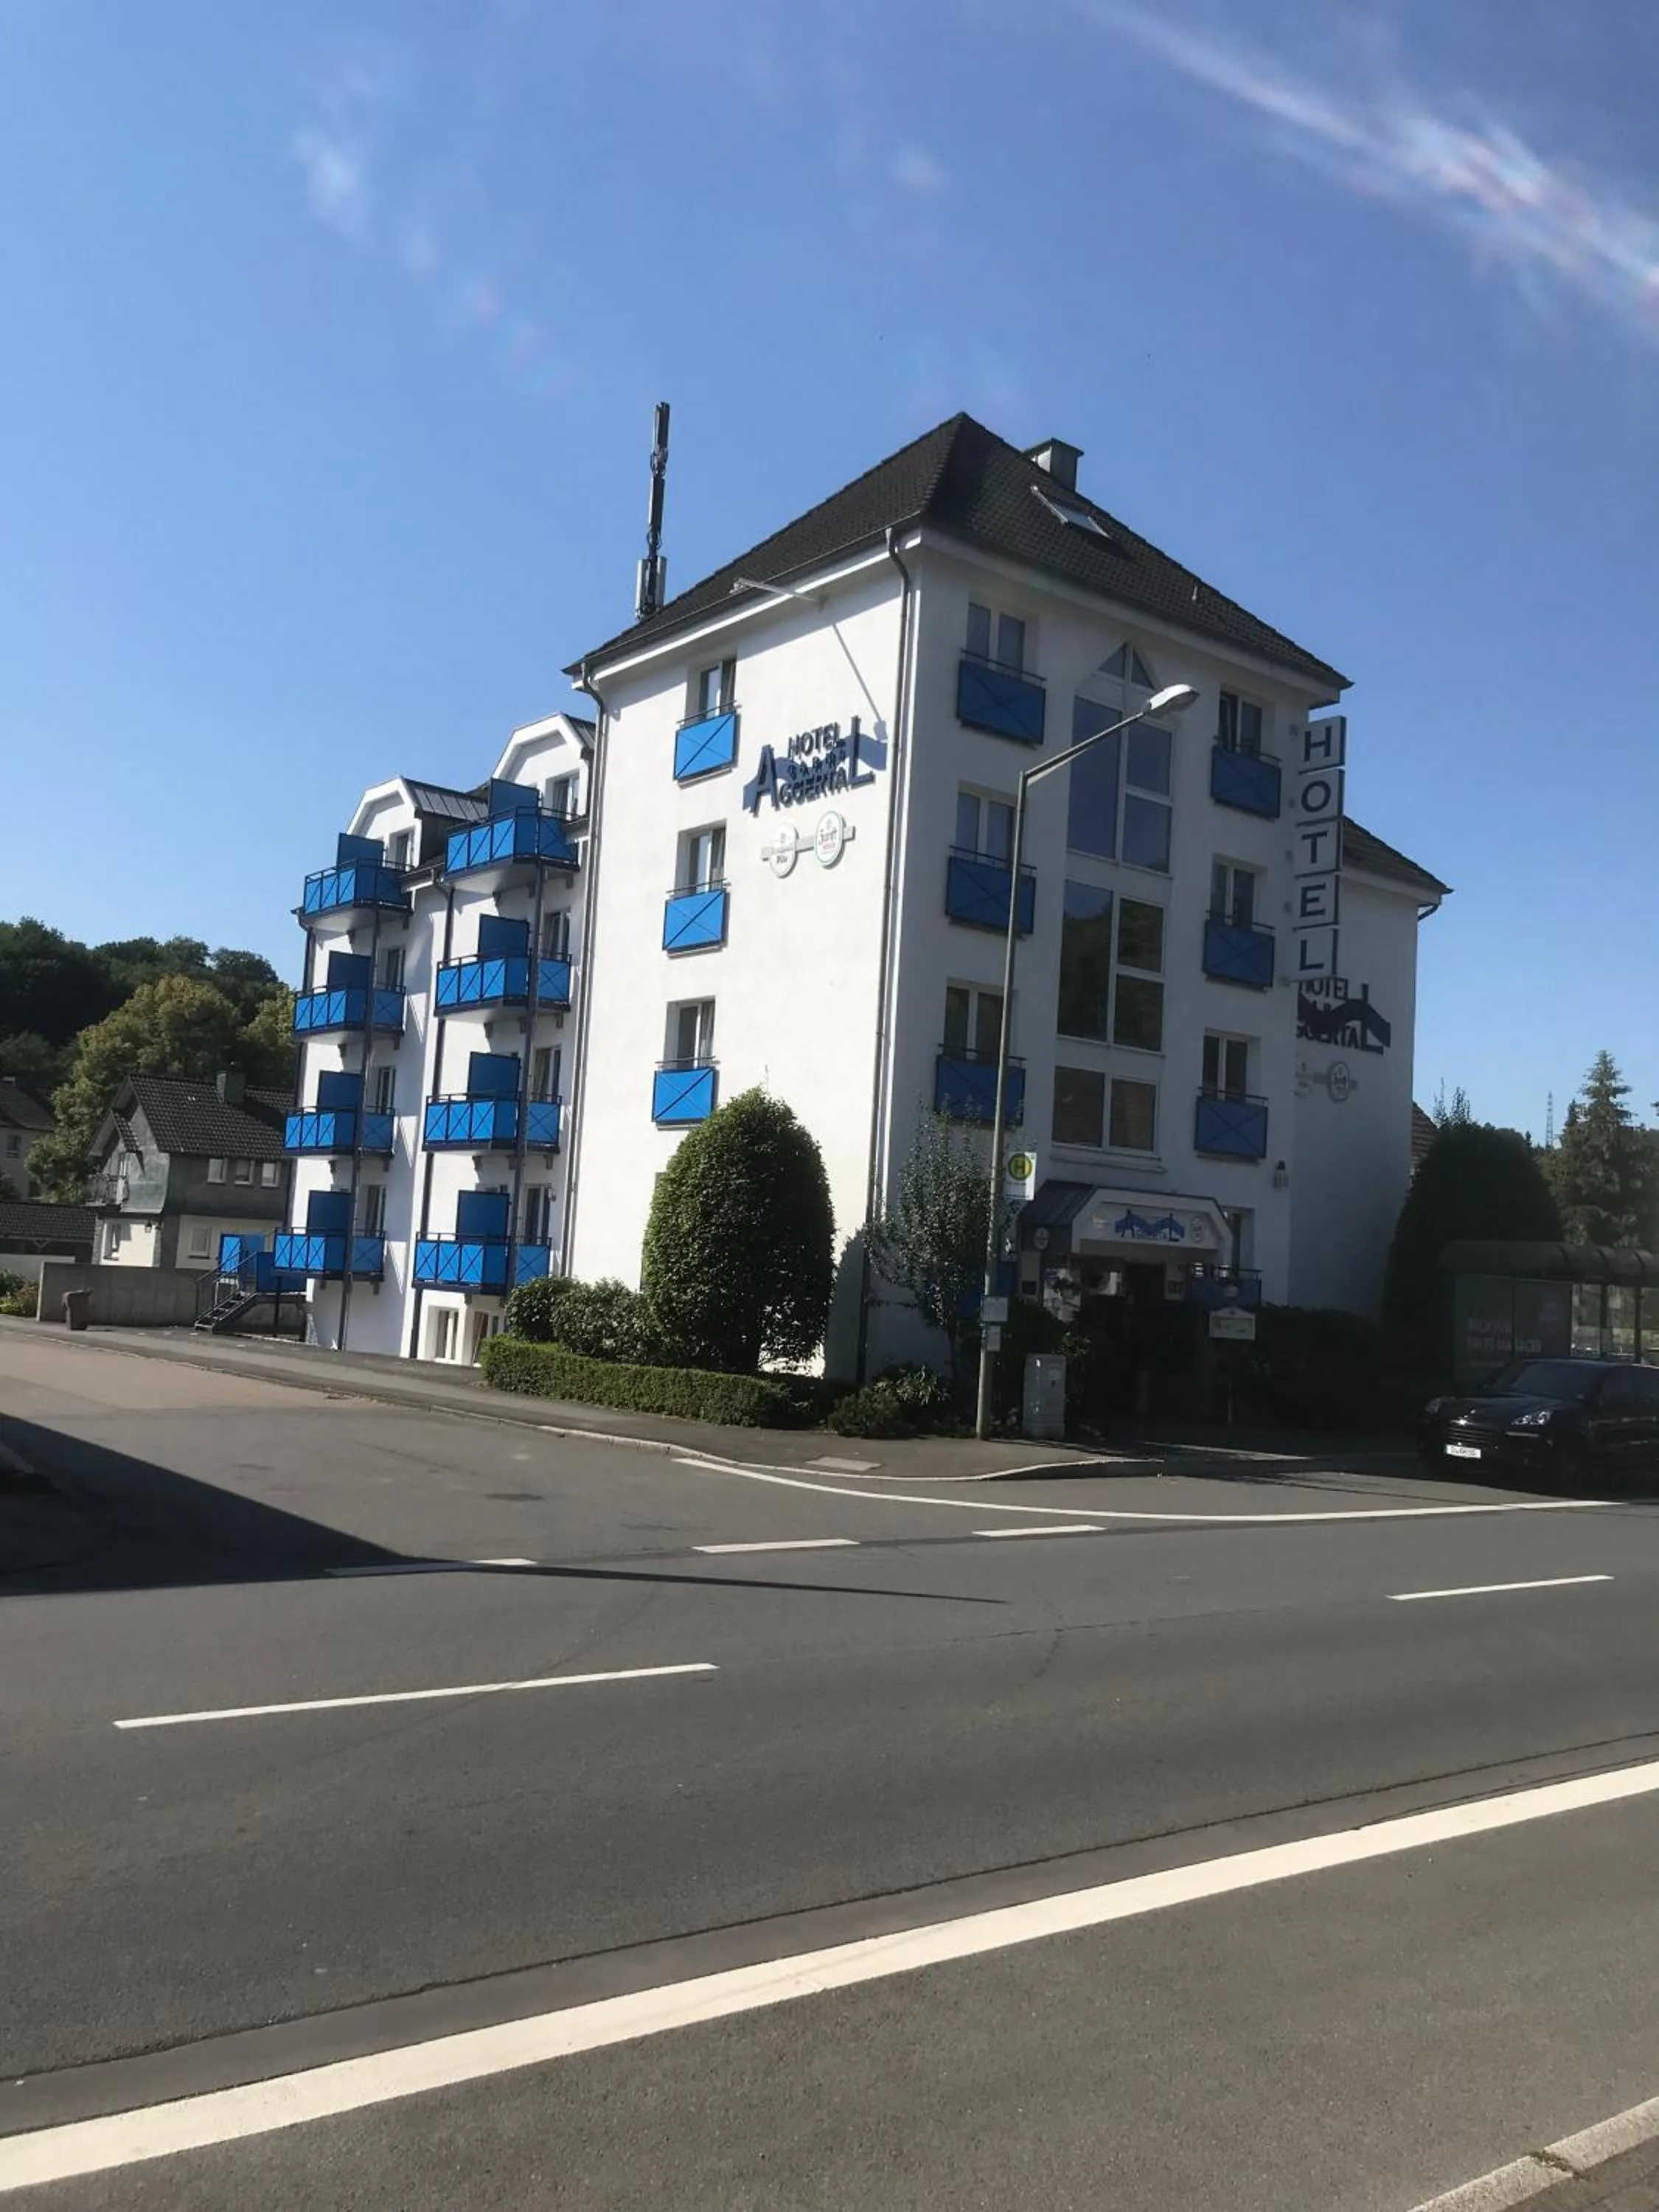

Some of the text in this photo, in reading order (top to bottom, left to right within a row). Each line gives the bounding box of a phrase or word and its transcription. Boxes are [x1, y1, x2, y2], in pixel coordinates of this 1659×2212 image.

[749, 715, 876, 818] AGGERTAL
[788, 722, 843, 760] HOTEL
[1298, 726, 1332, 971] HOTEL
[1296, 984, 1384, 1056] GGERTAL
